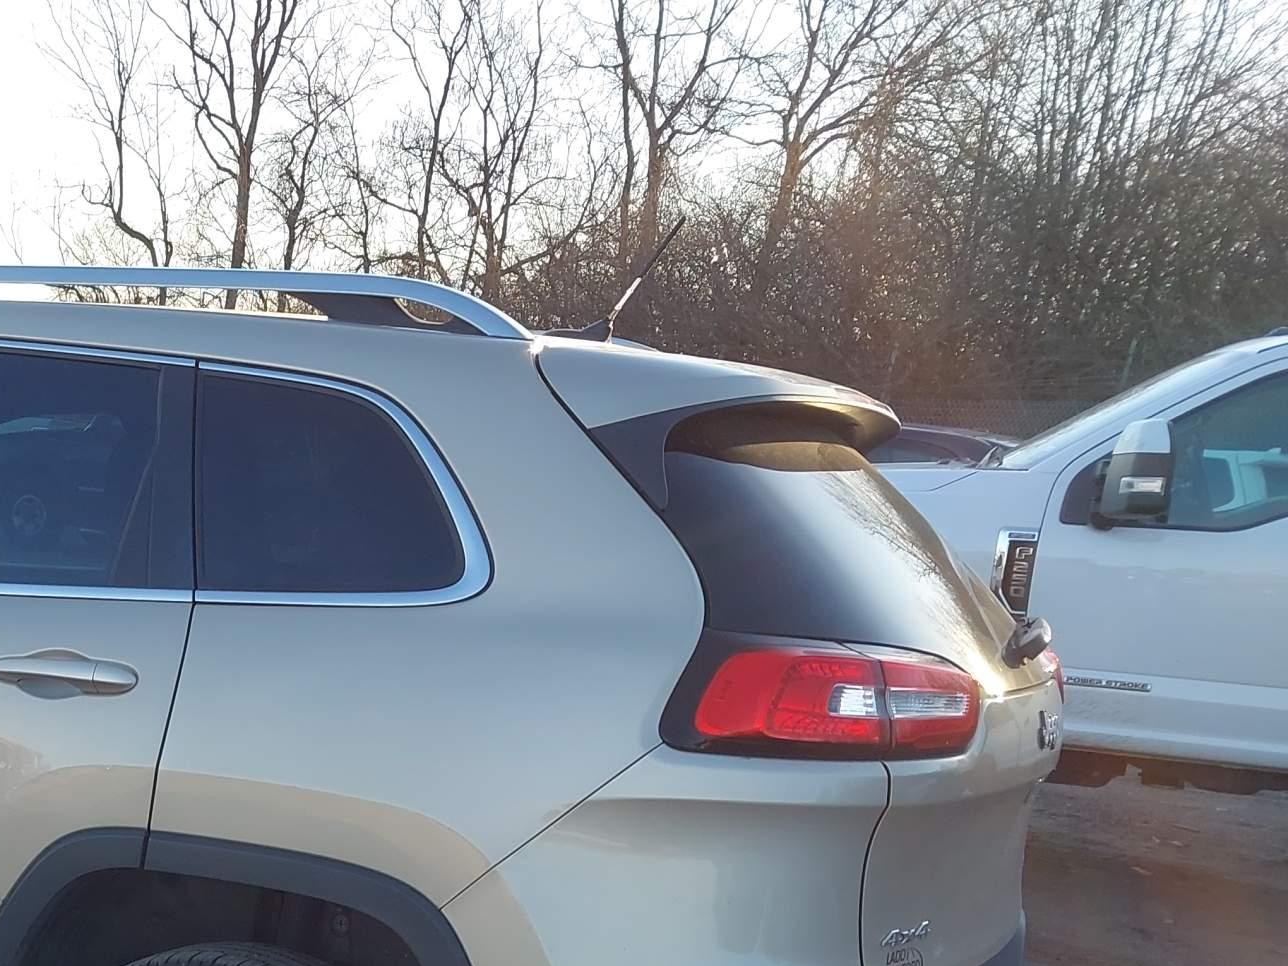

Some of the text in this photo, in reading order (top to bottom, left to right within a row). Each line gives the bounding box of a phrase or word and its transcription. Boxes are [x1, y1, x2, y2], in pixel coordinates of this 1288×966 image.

[1009, 546, 1033, 598] F250
[1066, 676, 1149, 689] POWER STROKE
